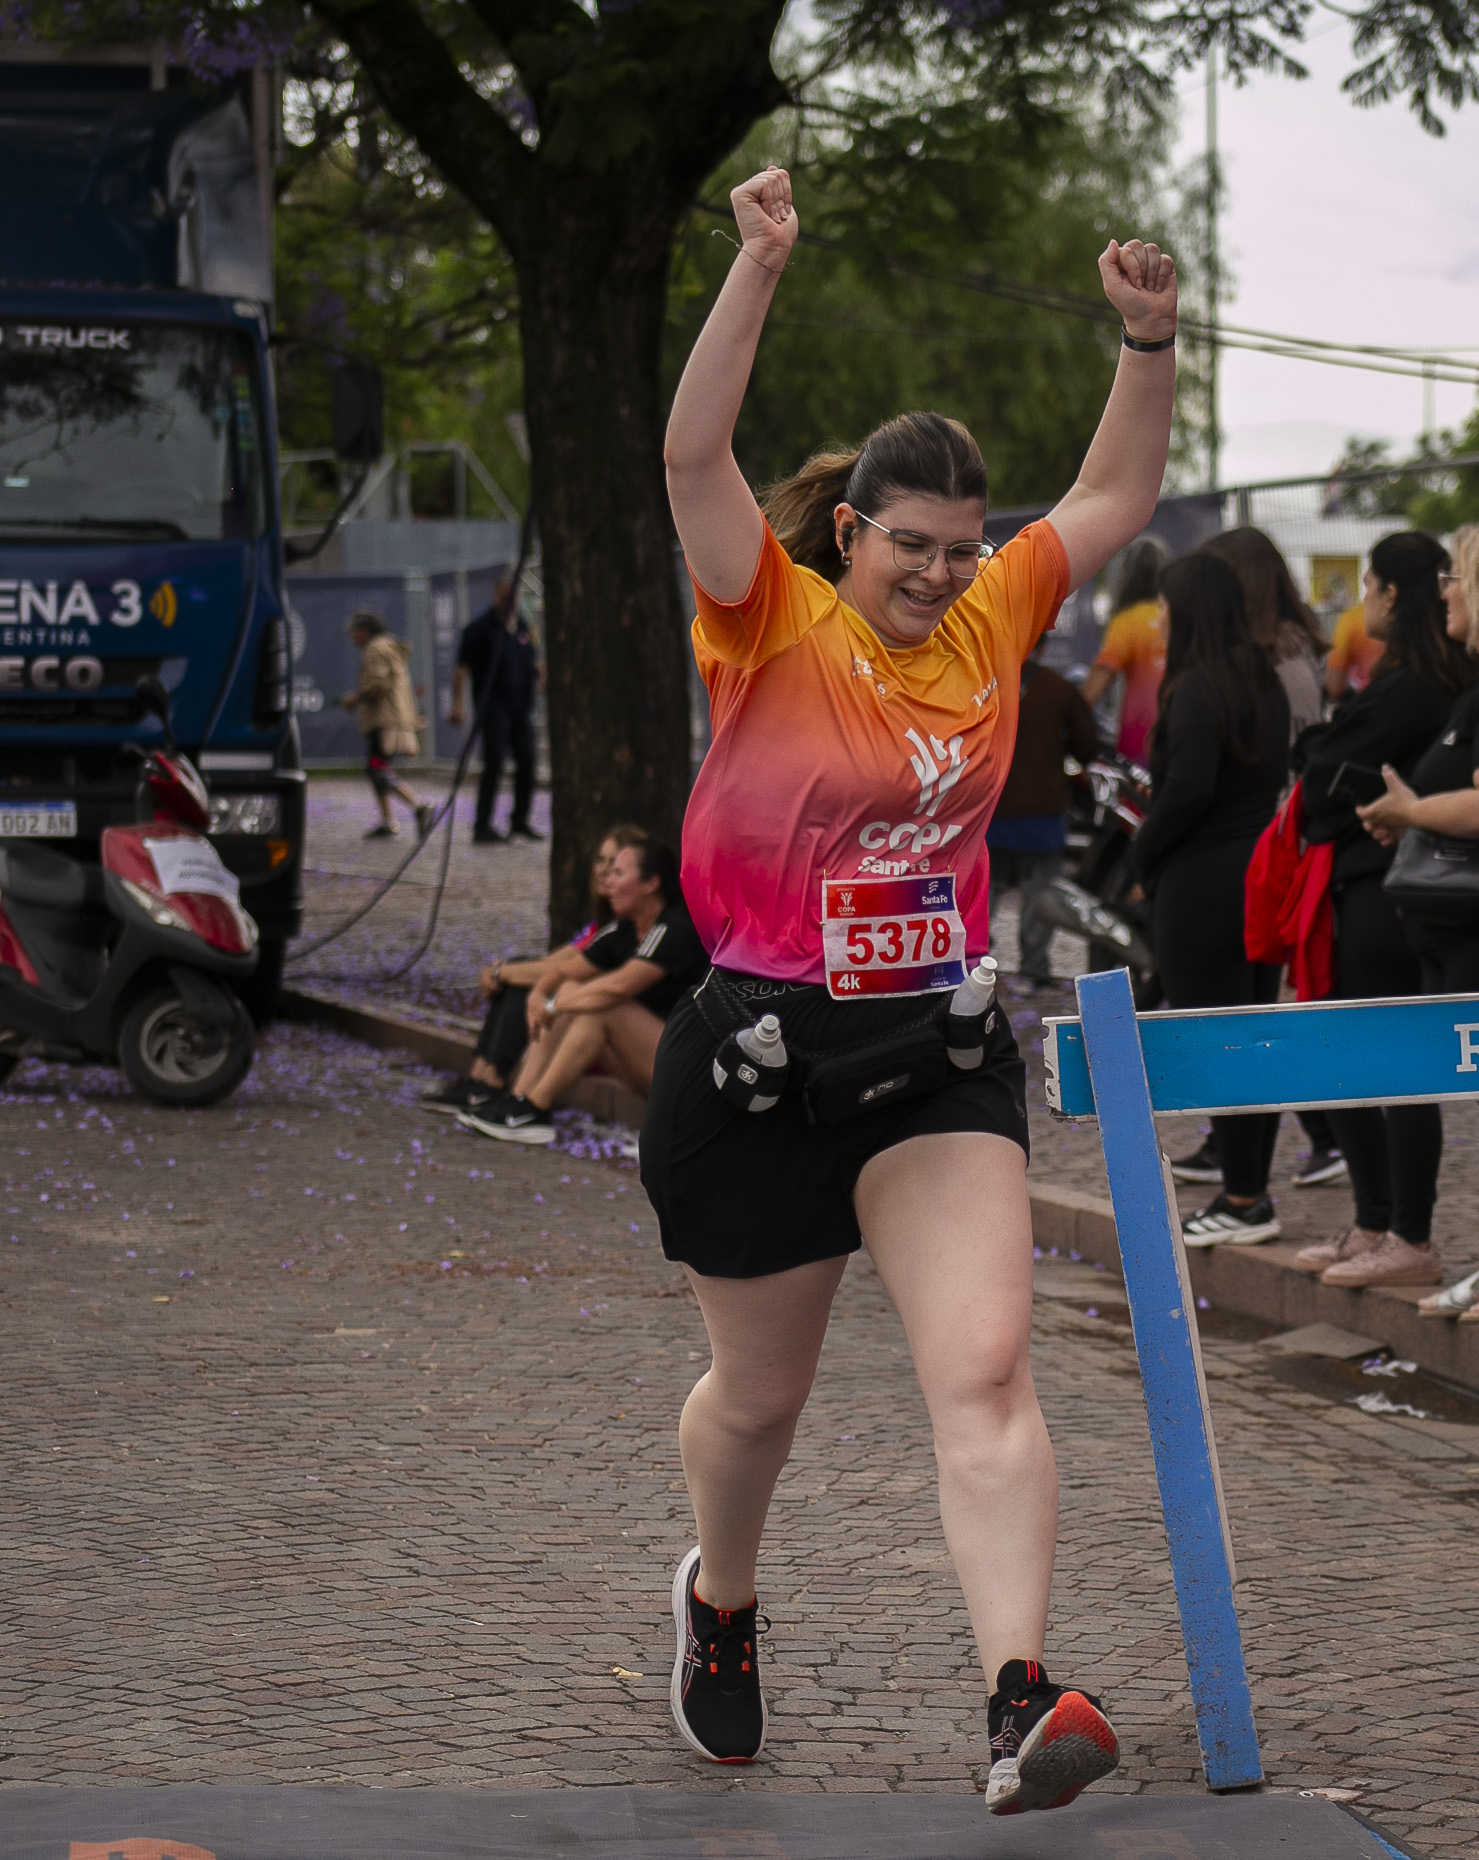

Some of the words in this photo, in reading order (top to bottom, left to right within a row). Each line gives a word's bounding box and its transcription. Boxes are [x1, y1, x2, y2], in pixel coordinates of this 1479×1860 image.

[17, 325, 131, 349] TRUCK
[0, 579, 100, 626] ENA
[109, 578, 142, 628] 3
[0, 654, 104, 691] ECO
[846, 917, 951, 966] 5378
[837, 973, 861, 990] 4k
